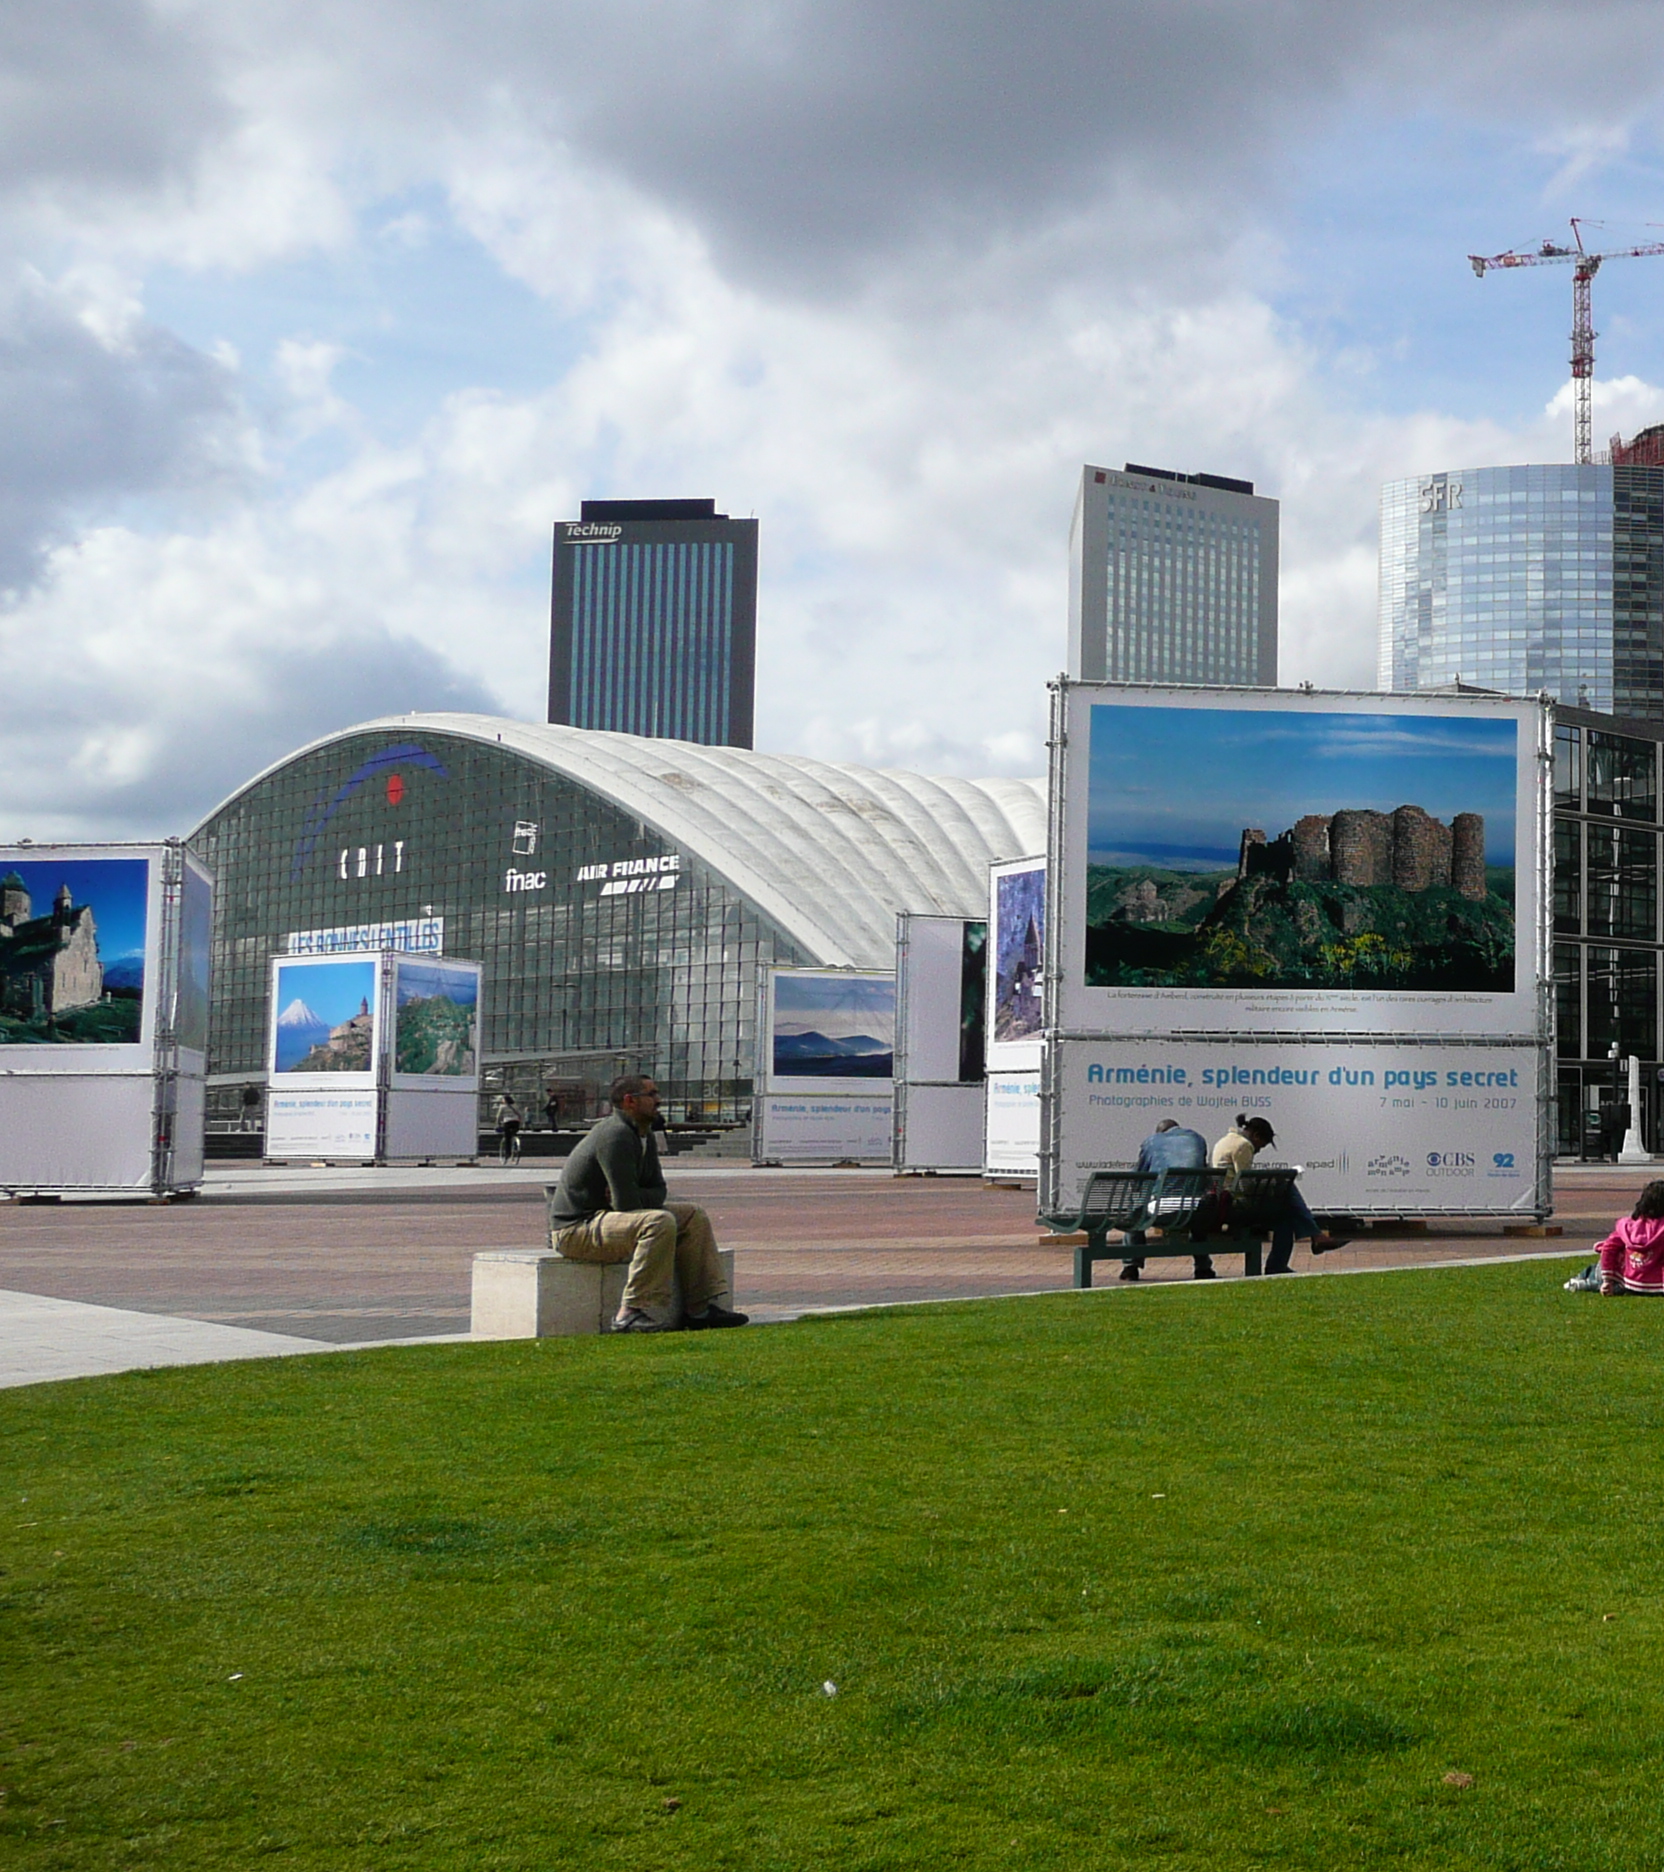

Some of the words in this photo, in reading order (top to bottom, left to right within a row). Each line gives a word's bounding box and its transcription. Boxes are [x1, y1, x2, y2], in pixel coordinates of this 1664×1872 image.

[1420, 482, 1463, 514] SFR
[565, 522, 622, 538] Technip
[577, 864, 608, 881] AIR
[612, 855, 680, 878] FRANCE
[505, 868, 547, 892] fnac
[1088, 1063, 1193, 1088] Arménie,
[1202, 1065, 1319, 1089] splendeur
[1328, 1066, 1375, 1086] d'un
[1384, 1069, 1437, 1090] pays
[1446, 1068, 1518, 1087] secret
[1089, 1094, 1174, 1108] Photographies
[1178, 1095, 1193, 1106] de
[1242, 1096, 1272, 1107] BUSS
[1380, 1097, 1387, 1108] 7
[1392, 1097, 1415, 1108] mai
[1435, 1097, 1448, 1108] 10
[1454, 1098, 1477, 1110] juin
[1484, 1098, 1517, 1109] 2007
[1306, 1159, 1335, 1170] epad
[1443, 1152, 1475, 1166] CBS
[1493, 1153, 1514, 1168] 92
[1426, 1168, 1475, 1177] OUTDOOR
